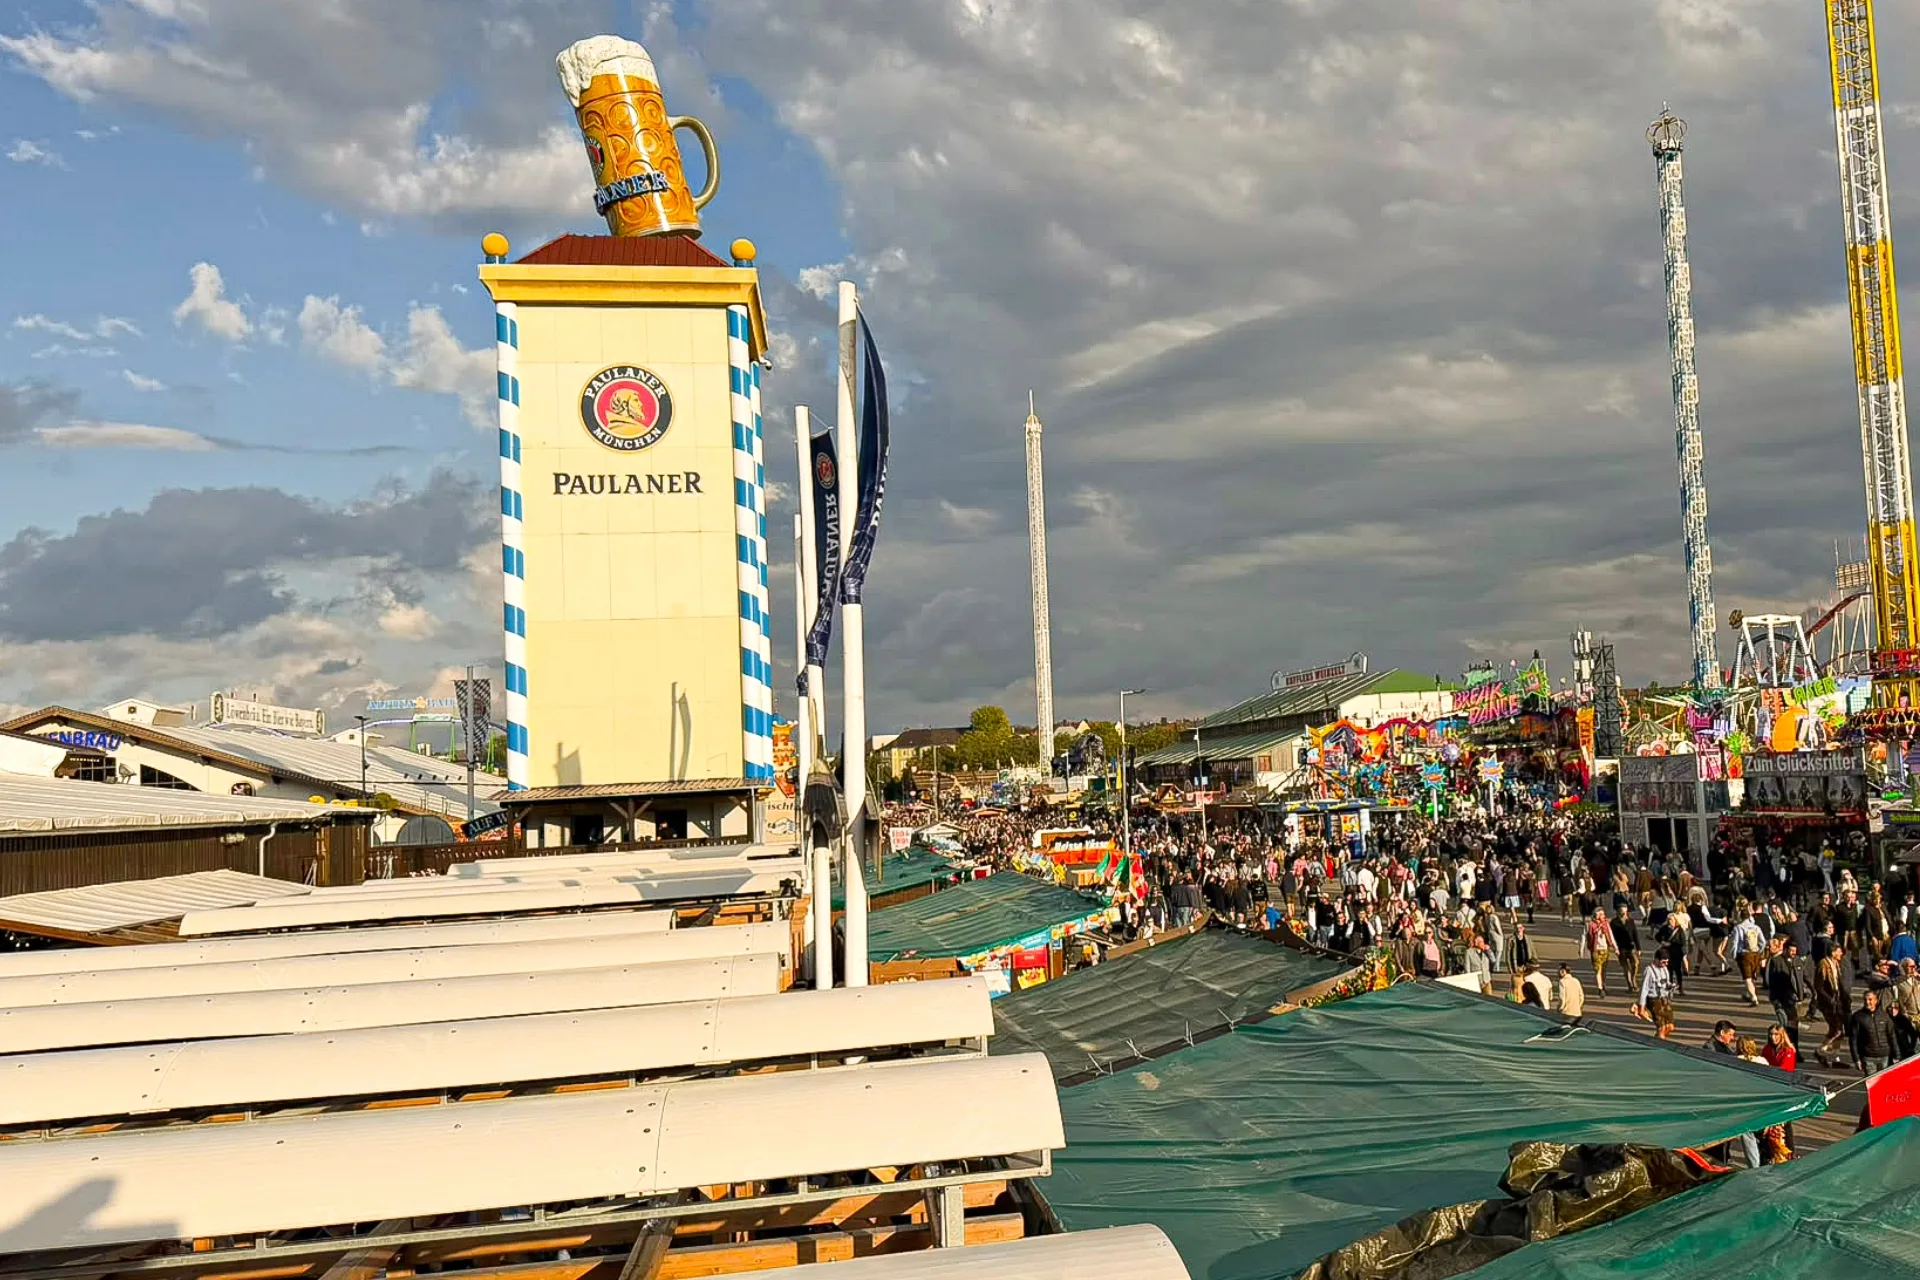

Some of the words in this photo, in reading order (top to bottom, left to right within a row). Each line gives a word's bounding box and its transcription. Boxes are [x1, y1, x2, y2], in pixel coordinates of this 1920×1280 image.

[584, 367, 667, 398] PAULANER
[593, 427, 662, 449] MÜNCHEN
[553, 471, 703, 495] PAULANER
[1453, 681, 1505, 711] BREAK
[1782, 677, 1836, 706] LASER
[1468, 694, 1521, 726] DANCE
[1744, 756, 1773, 772] Zum
[1777, 752, 1858, 772] Glücksritter
[468, 817, 495, 836] AUF
